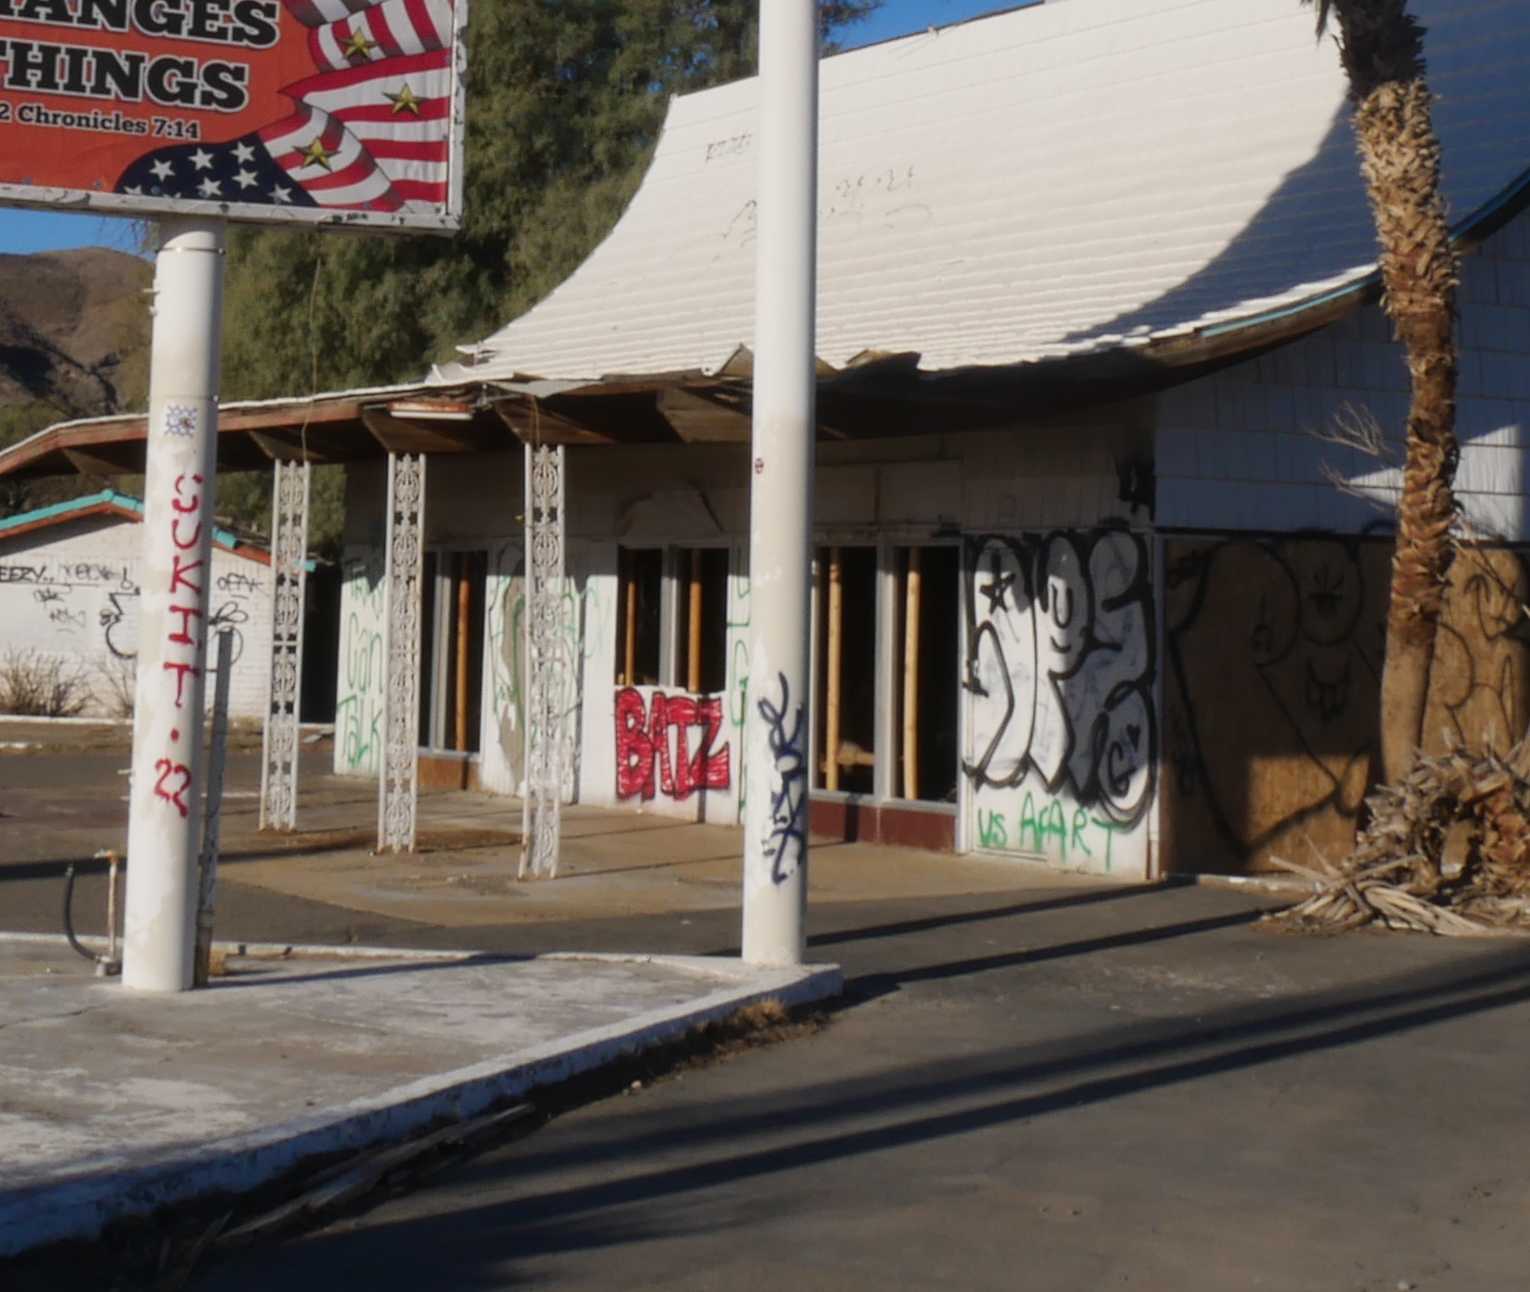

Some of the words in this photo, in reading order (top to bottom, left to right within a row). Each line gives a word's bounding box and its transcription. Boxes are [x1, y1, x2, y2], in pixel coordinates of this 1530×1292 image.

[16, 104, 149, 135] Chronicles
[152, 117, 200, 140] 7:14
[614, 687, 731, 803] BATZ
